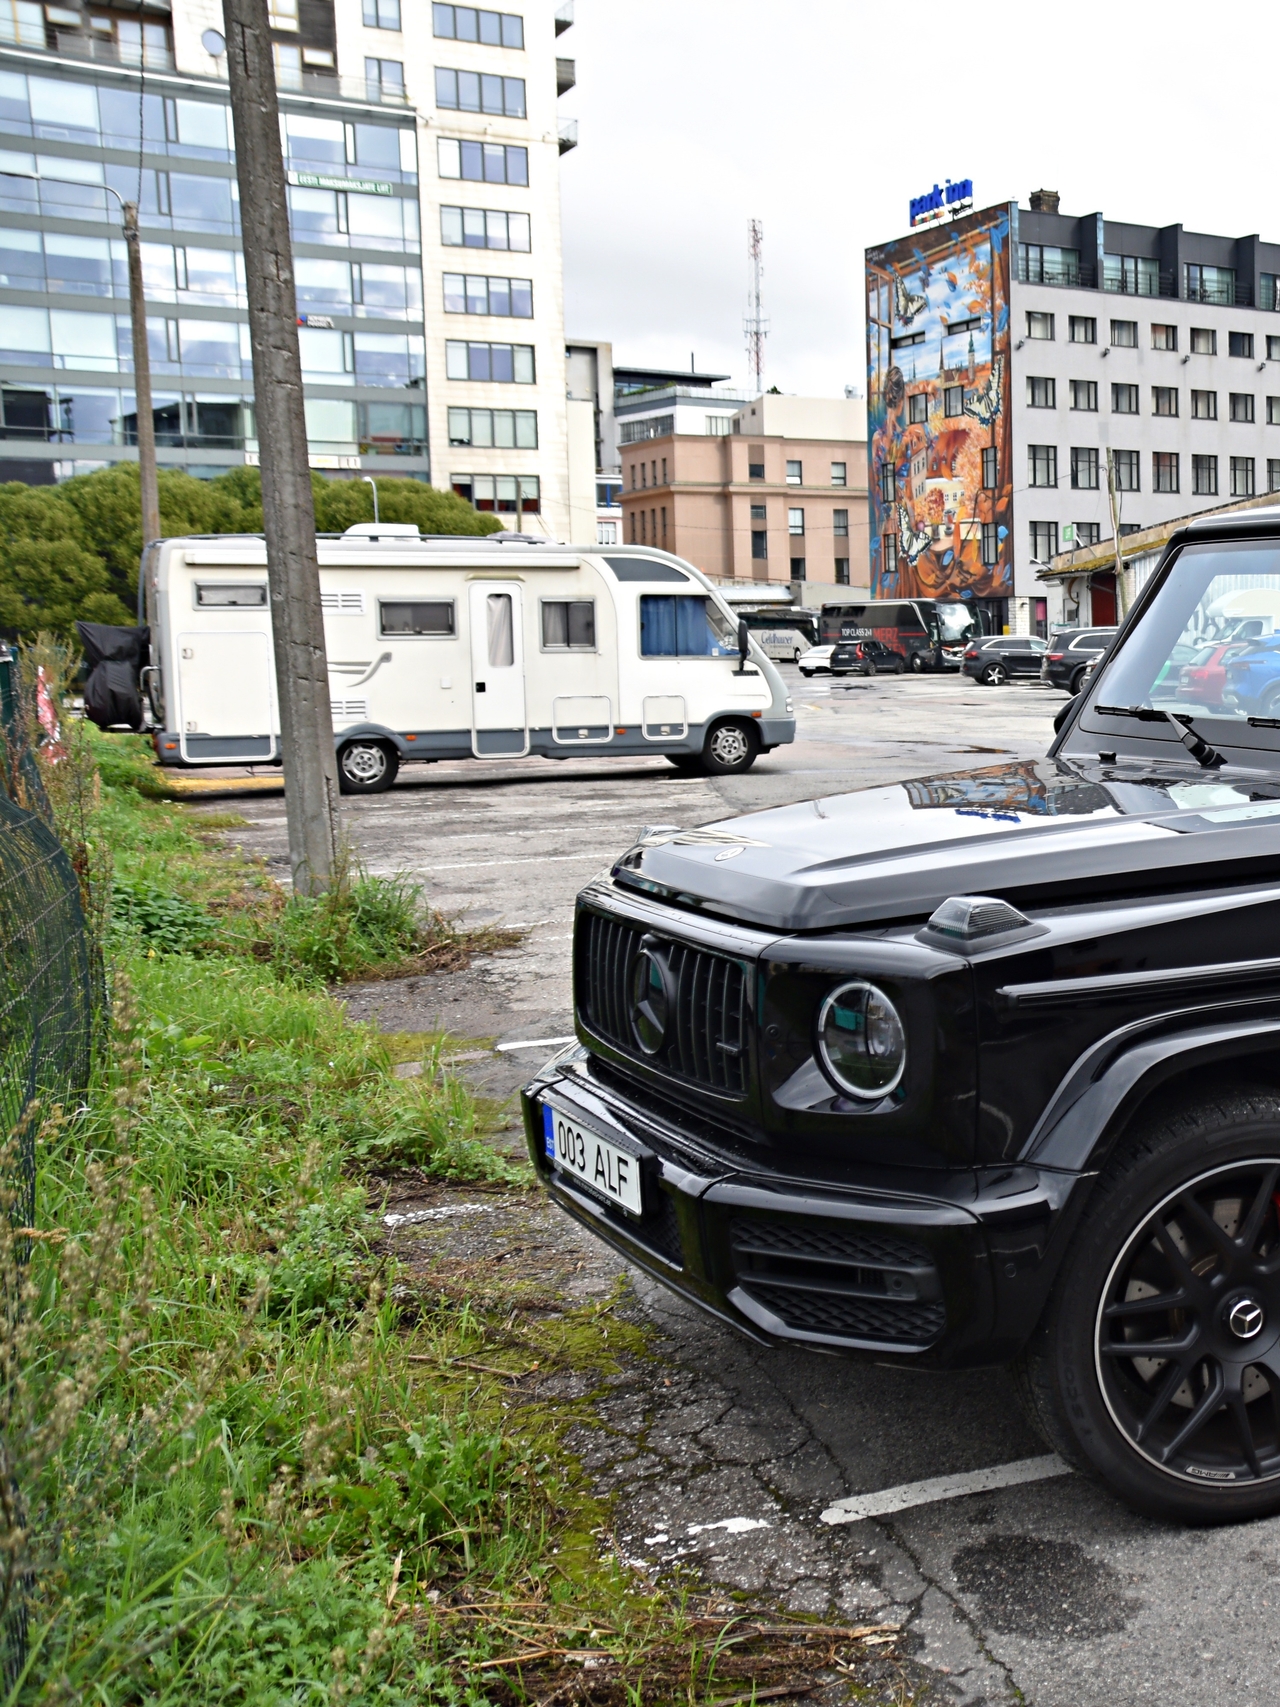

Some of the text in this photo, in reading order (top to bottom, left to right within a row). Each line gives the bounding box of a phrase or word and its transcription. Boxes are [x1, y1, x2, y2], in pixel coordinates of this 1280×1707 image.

[910, 184, 945, 227] park
[945, 179, 973, 204] inn
[850, 628, 865, 637] CLASS
[873, 627, 899, 643] MERZ
[558, 1120, 585, 1172] 003
[594, 1144, 629, 1198] ALF
